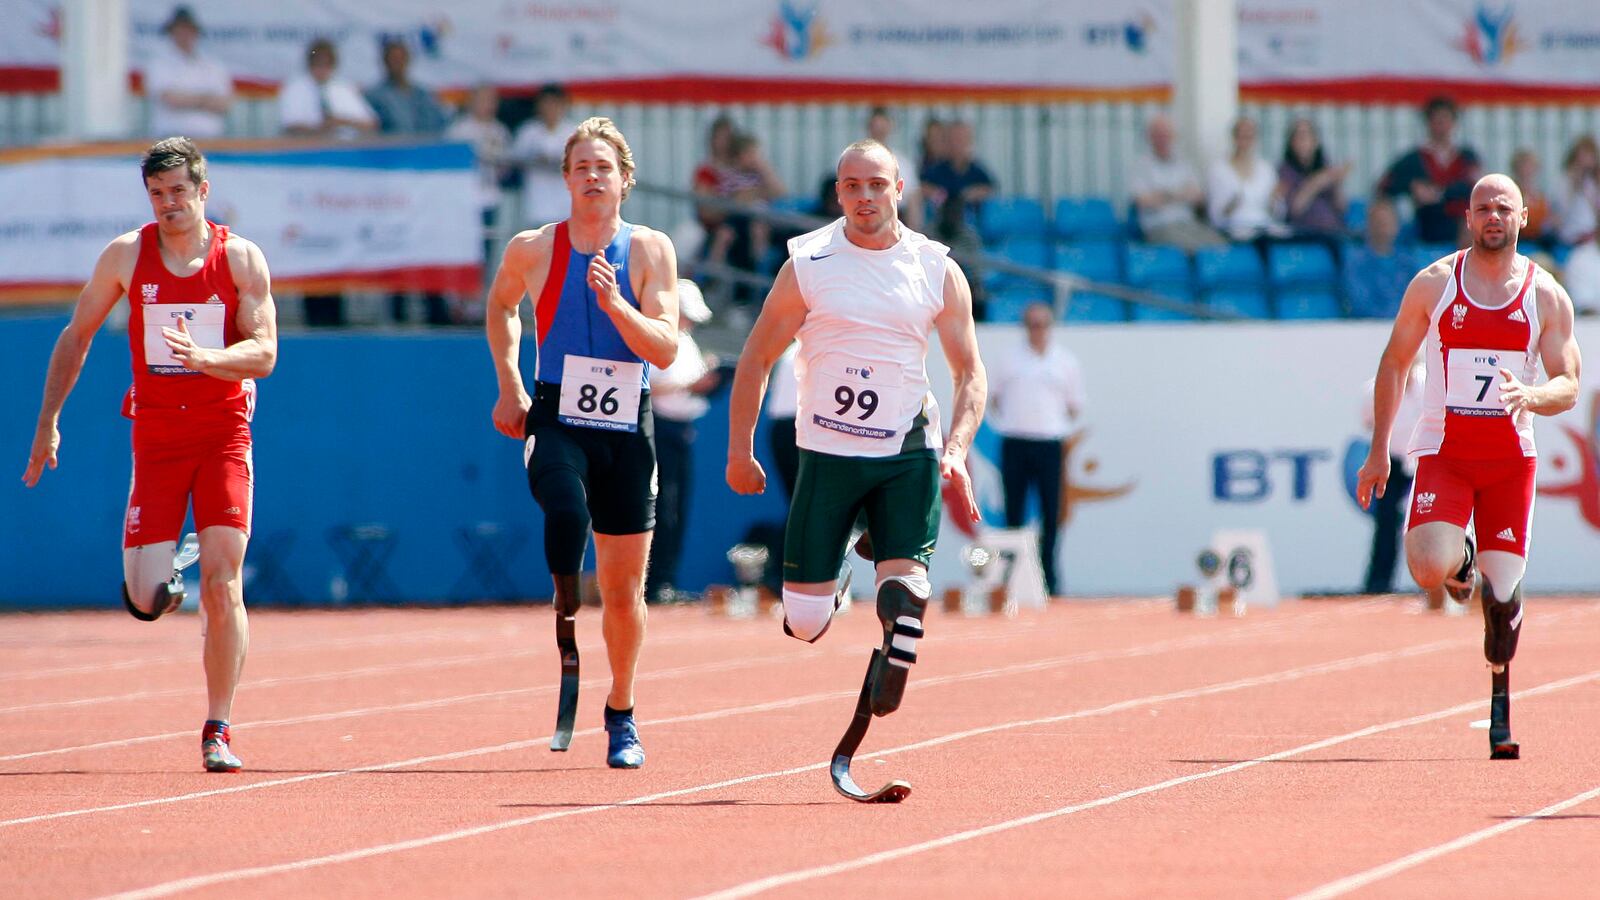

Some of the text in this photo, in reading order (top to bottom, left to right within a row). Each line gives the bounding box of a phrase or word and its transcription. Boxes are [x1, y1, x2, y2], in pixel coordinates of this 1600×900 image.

[846, 367, 860, 375] BT
[578, 384, 619, 415] 86
[835, 386, 878, 420] 99
[1475, 375, 1494, 401] 7
[566, 418, 629, 430] englandsnorthwest
[819, 419, 887, 437] englandsnorthwest
[1213, 450, 1329, 501] BT
[998, 549, 1016, 586] 7
[1228, 547, 1253, 588] 6
